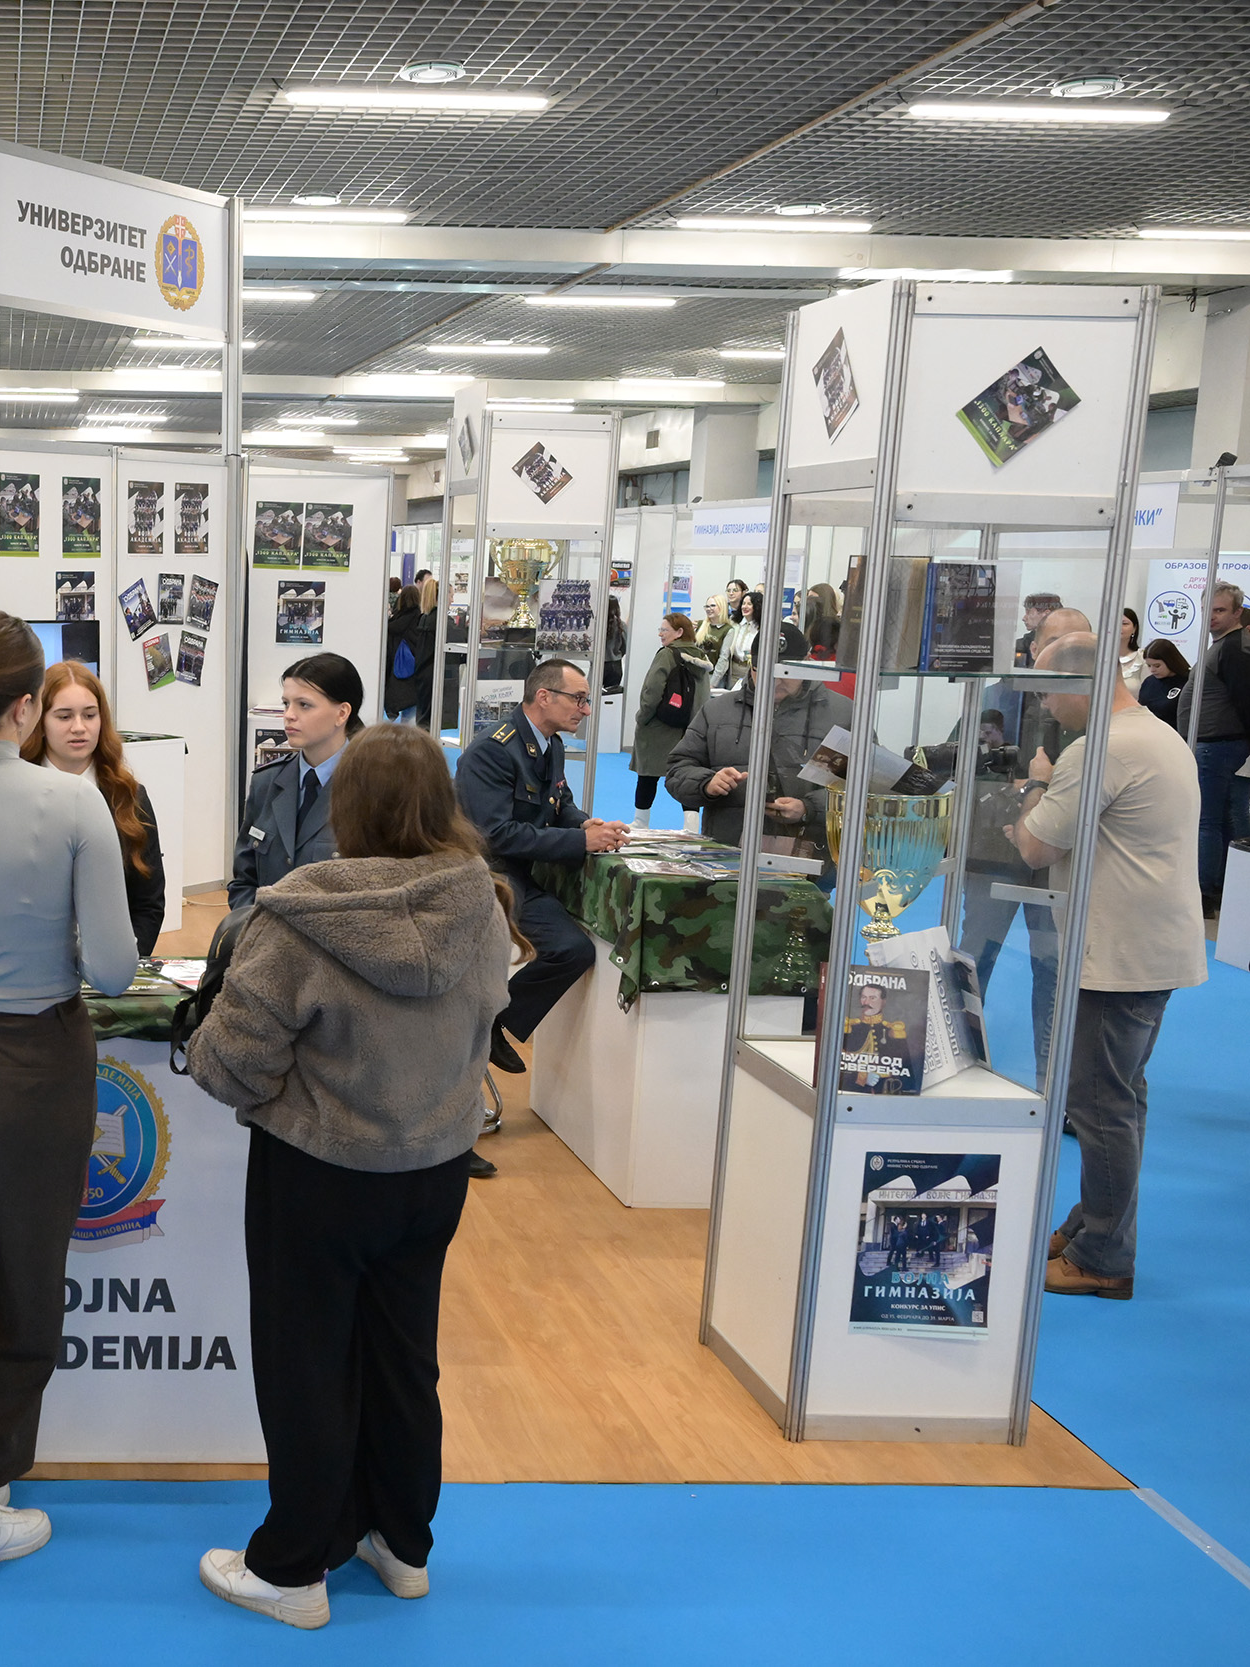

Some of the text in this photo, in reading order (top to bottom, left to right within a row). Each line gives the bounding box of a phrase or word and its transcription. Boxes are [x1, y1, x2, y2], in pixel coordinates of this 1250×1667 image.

[17, 200, 147, 250] УНИВЕРЗИТЕТ
[60, 246, 146, 283] ОДБРАНЕ
[745, 522, 770, 534] МАРКОВИ
[839, 1061, 911, 1077] ОВЕРЕЊА
[881, 1056, 903, 1068] ОД
[95, 1220, 142, 1239] ИМОВИНА
[891, 1271, 950, 1286] ВОЈНА
[864, 1286, 976, 1301] ГИМНАЗИЈА
[56, 1336, 237, 1370] DEMIJA
